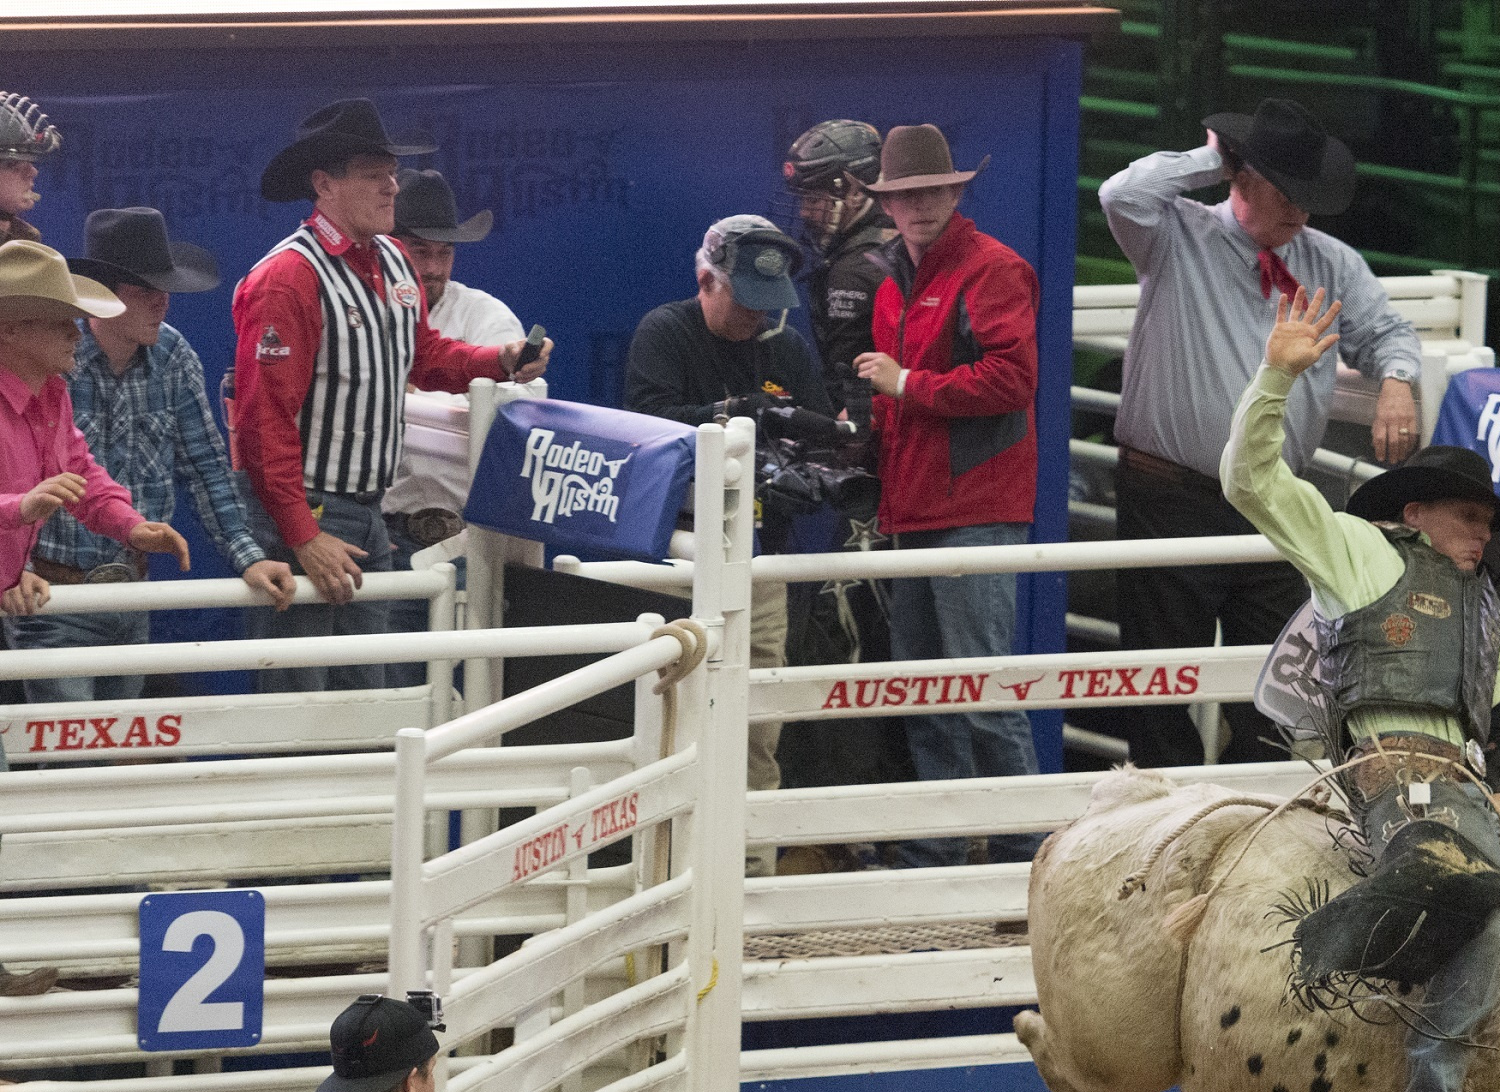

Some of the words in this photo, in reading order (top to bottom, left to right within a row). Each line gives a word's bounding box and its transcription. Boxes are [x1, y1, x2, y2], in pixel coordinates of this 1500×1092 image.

[520, 427, 606, 478] Rodeo
[531, 469, 620, 524] Austin
[822, 674, 989, 709] AUSTIN
[1058, 665, 1200, 699] TEXAS
[25, 714, 182, 752] TEXAS
[513, 824, 569, 881] AUSTIN
[592, 792, 638, 842] TEXAS
[157, 910, 245, 1034] 2
